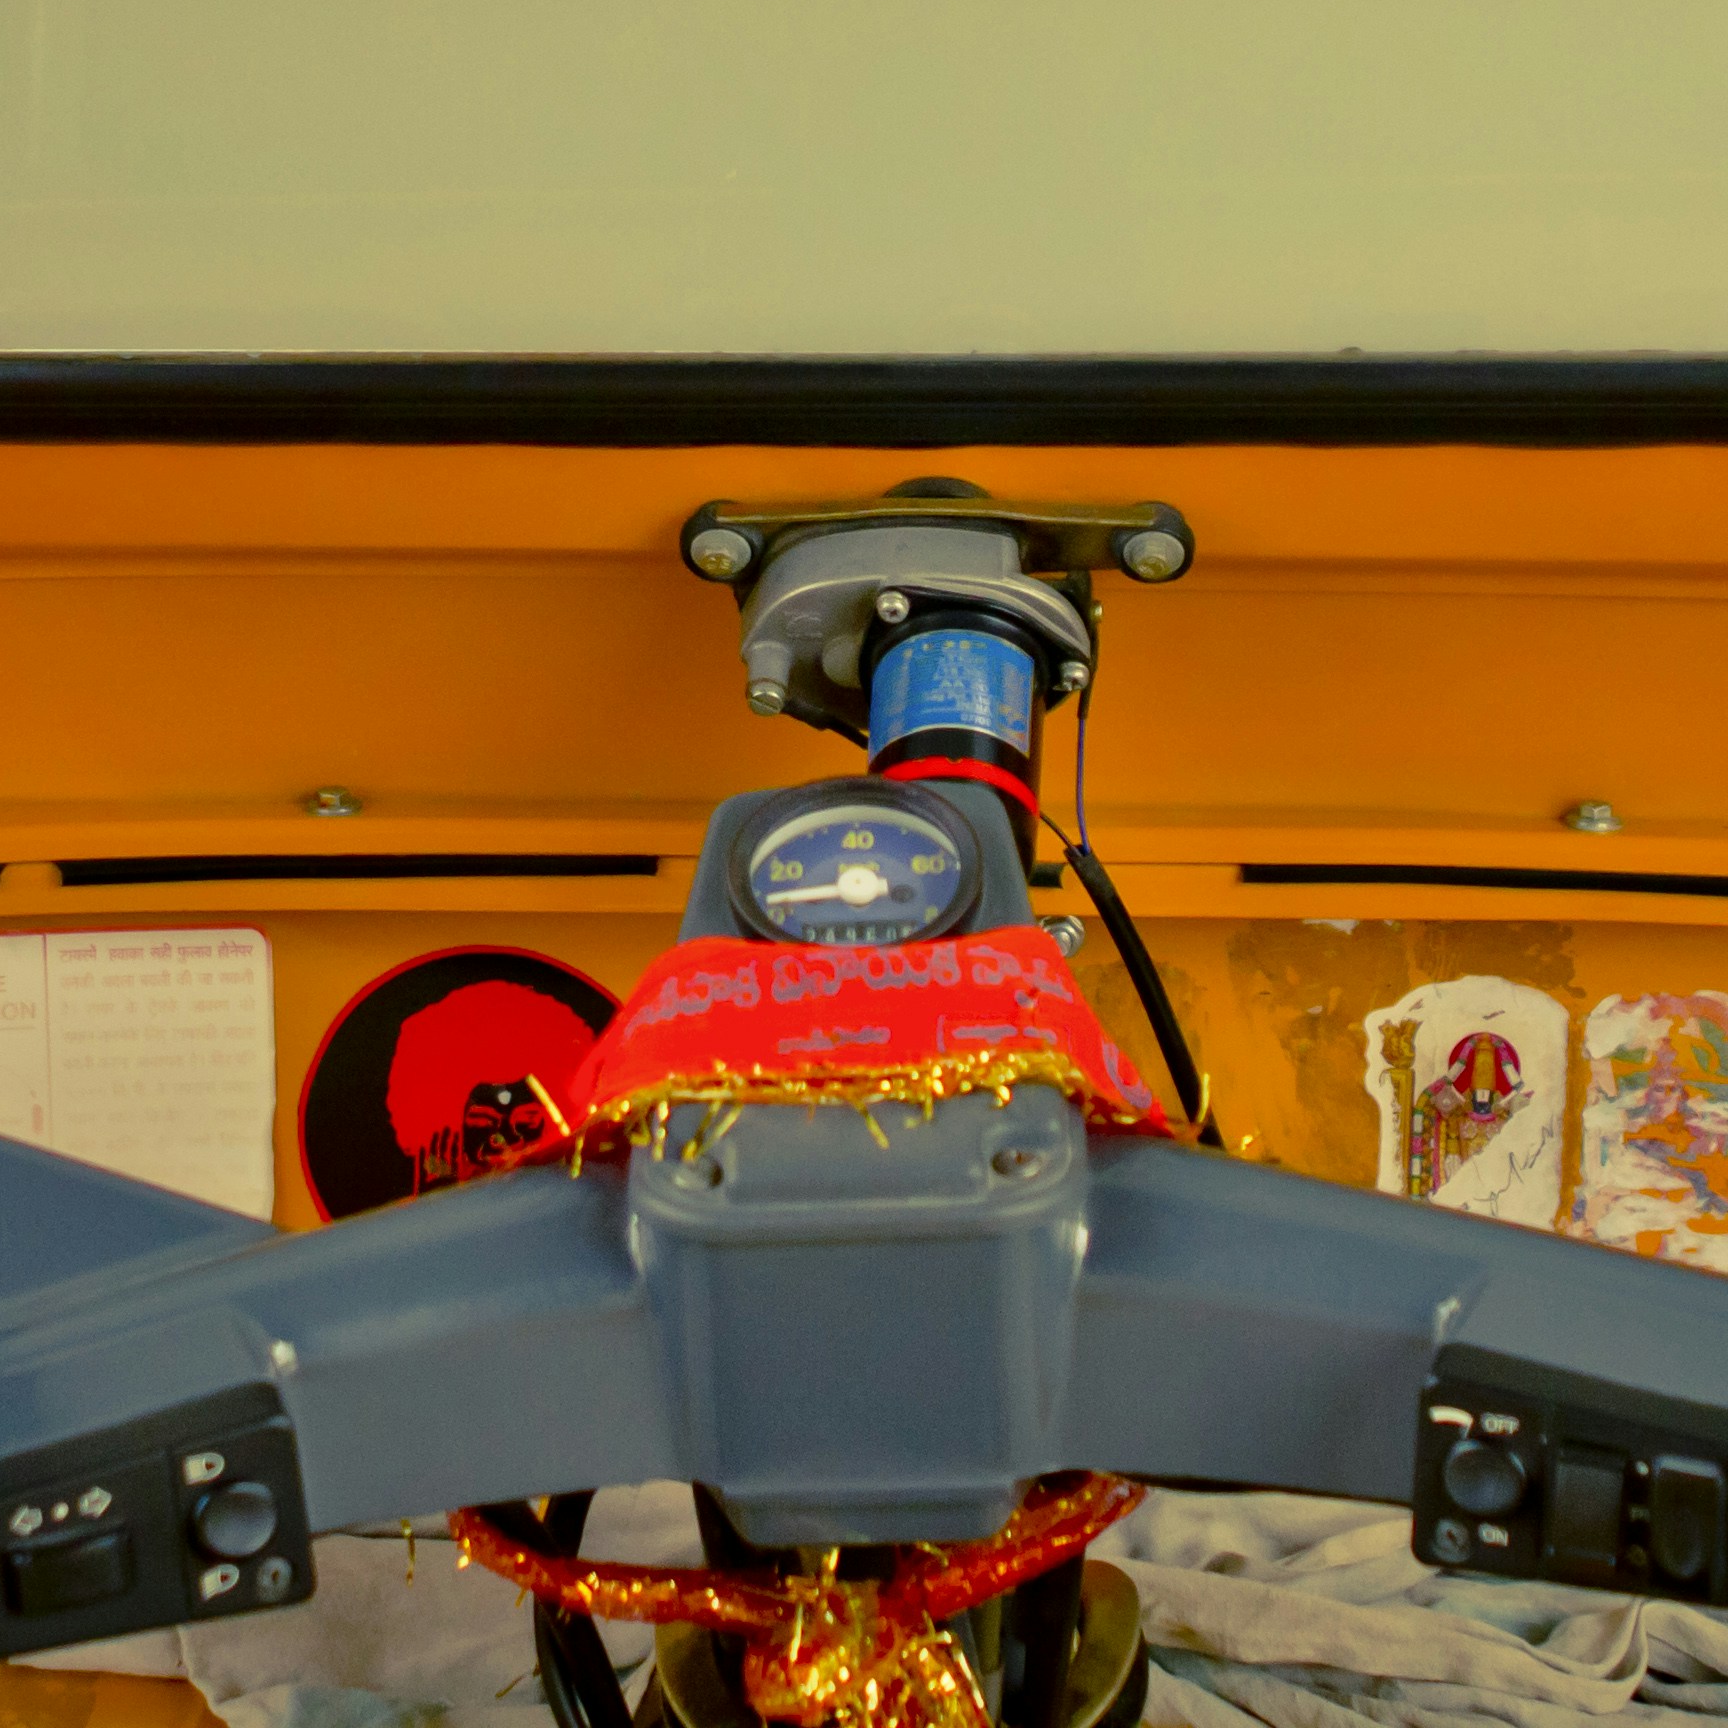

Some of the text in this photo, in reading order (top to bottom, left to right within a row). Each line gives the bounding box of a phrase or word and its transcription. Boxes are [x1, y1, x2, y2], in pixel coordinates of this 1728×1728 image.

[841, 831, 874, 849] 40
[770, 858, 803, 881] 20
[911, 855, 945, 874] 60
[1480, 1411, 1519, 1434] OFF
[1478, 1522, 1508, 1547] ON
